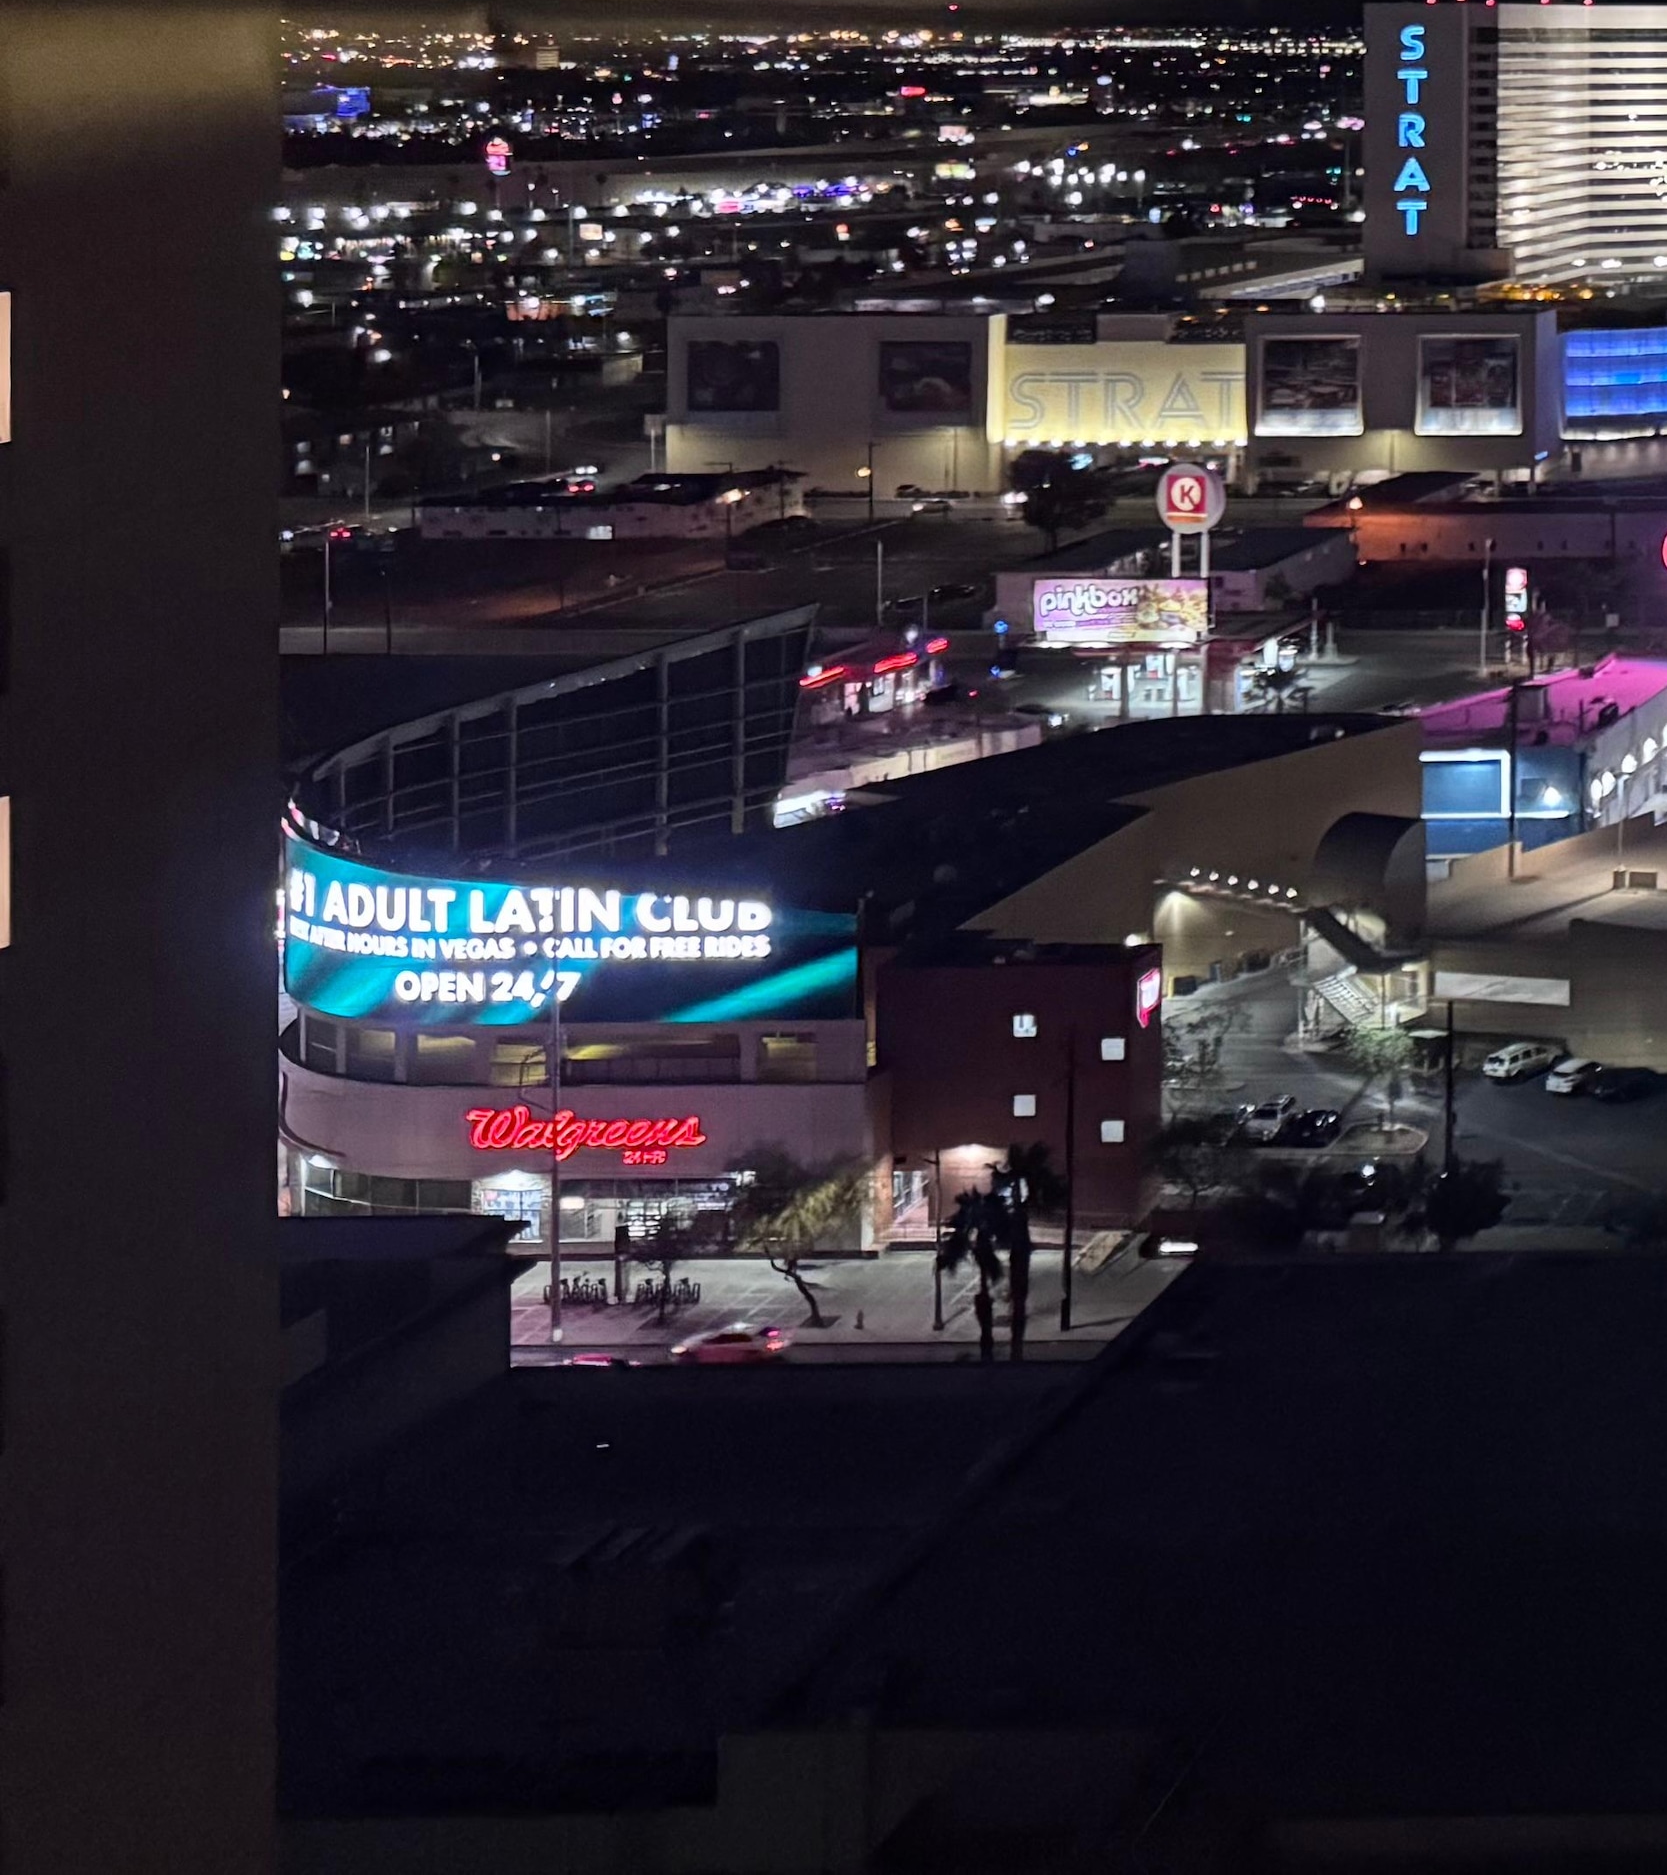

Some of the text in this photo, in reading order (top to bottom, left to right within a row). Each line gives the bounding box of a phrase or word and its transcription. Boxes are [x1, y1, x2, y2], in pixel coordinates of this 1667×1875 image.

[1393, 25, 1431, 236] STRAT
[1009, 371, 1244, 429] STRAT
[1040, 584, 1139, 618] pinkbox
[322, 880, 456, 934] ADULT
[469, 886, 622, 933] LATIN
[346, 932, 409, 958] HOURS
[411, 937, 436, 960] IN
[438, 936, 516, 961] VEGAS
[542, 936, 599, 959] CALL
[600, 935, 648, 960] FOR
[649, 935, 702, 960] FREE
[394, 970, 582, 1009] OPEN 24/7
[465, 1104, 707, 1162] Walgreens
